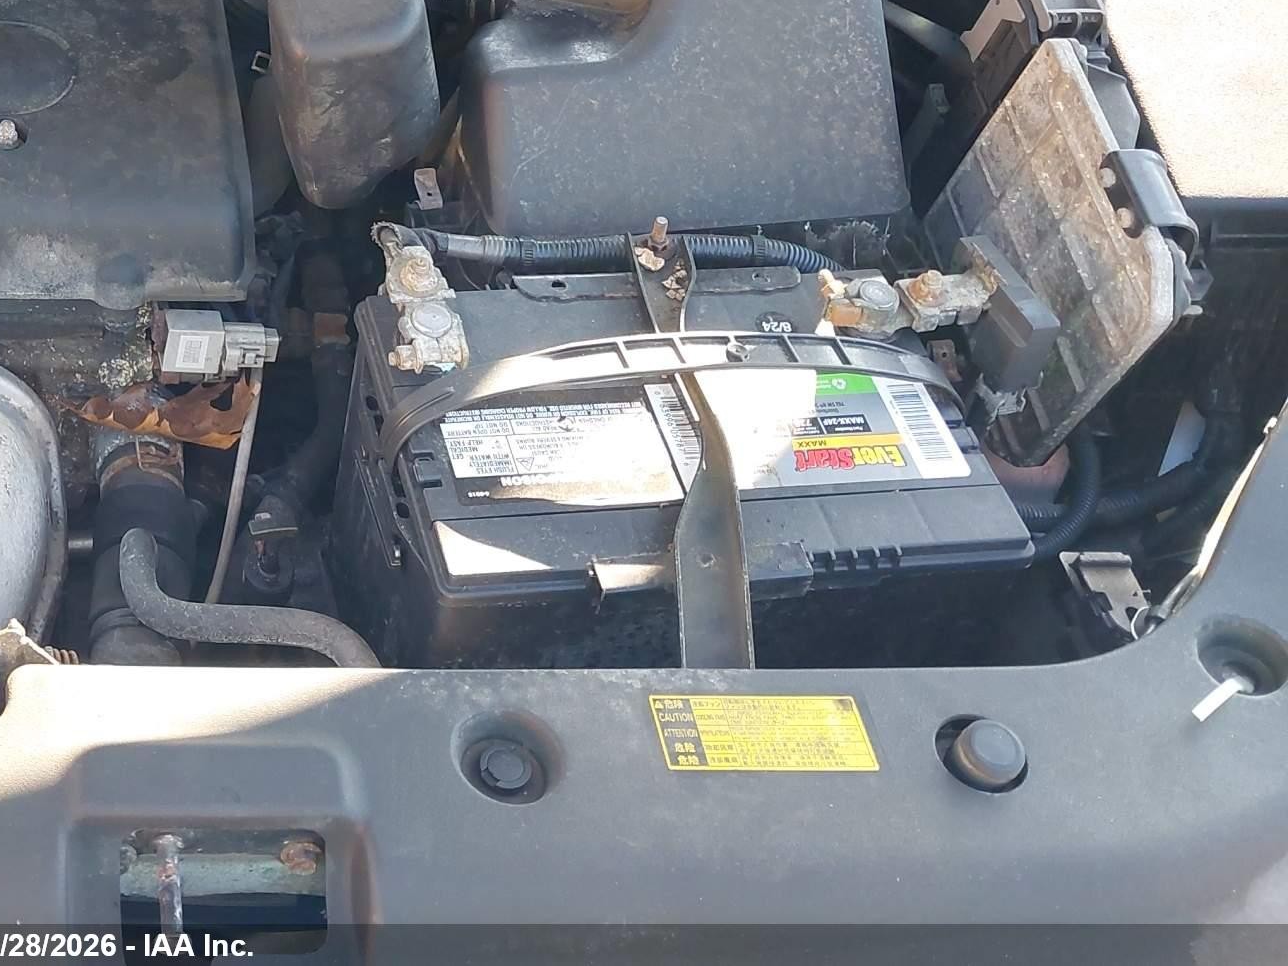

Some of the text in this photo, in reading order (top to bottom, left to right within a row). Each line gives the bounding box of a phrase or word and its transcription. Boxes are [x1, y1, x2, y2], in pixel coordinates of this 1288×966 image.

[762, 322, 792, 332] 8/24
[797, 439, 827, 448] MAXX
[794, 445, 907, 472] EverStart
[659, 713, 694, 722] CAUTION
[664, 728, 698, 738] ATTENTION
